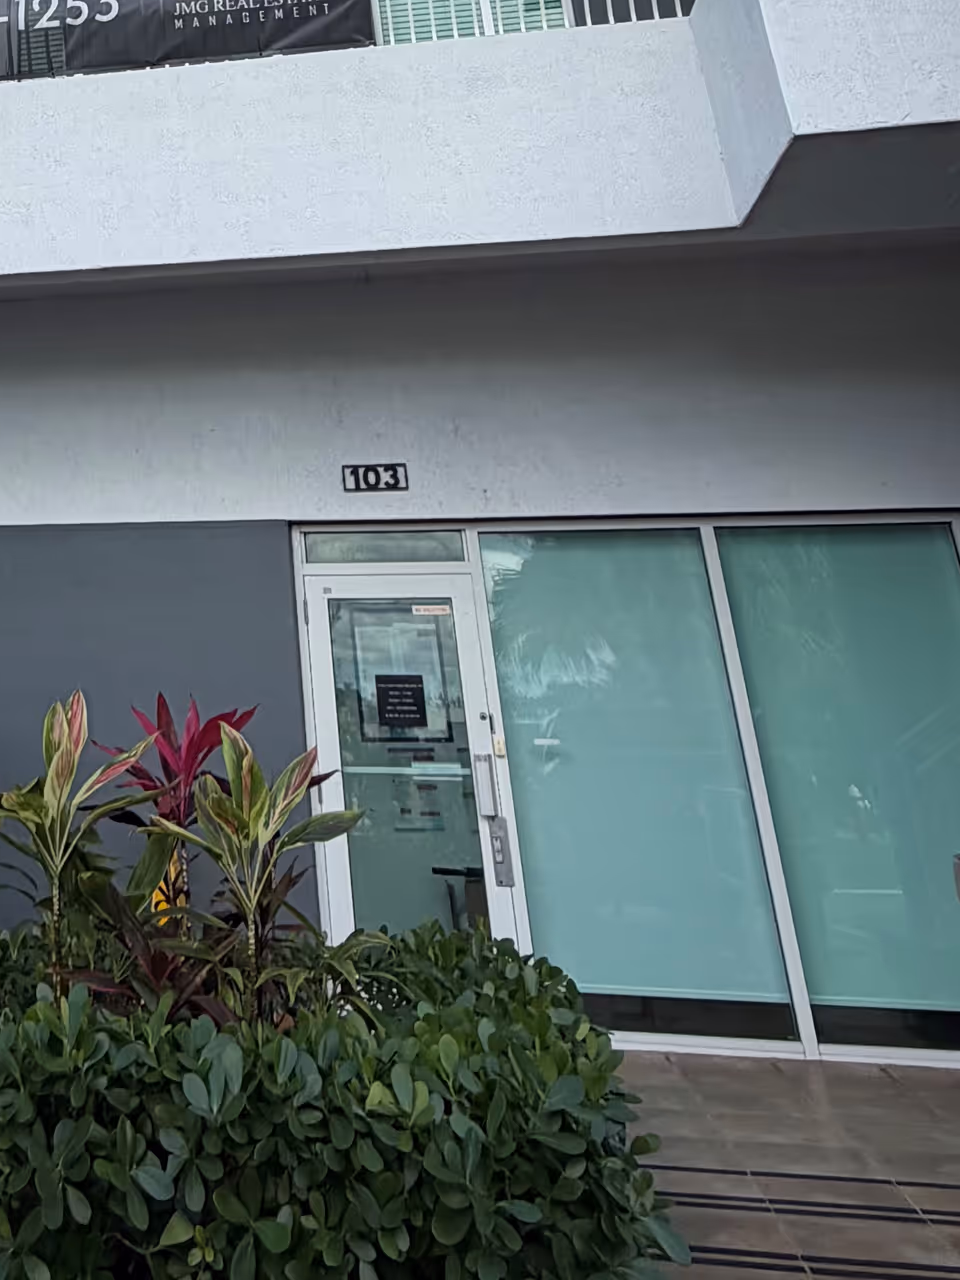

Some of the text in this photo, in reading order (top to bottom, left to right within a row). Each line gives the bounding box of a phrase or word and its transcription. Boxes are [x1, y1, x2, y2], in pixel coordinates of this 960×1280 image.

[174, 0, 209, 16] JMG
[174, 3, 329, 29] MANAGEMENT
[350, 465, 400, 489] 103
